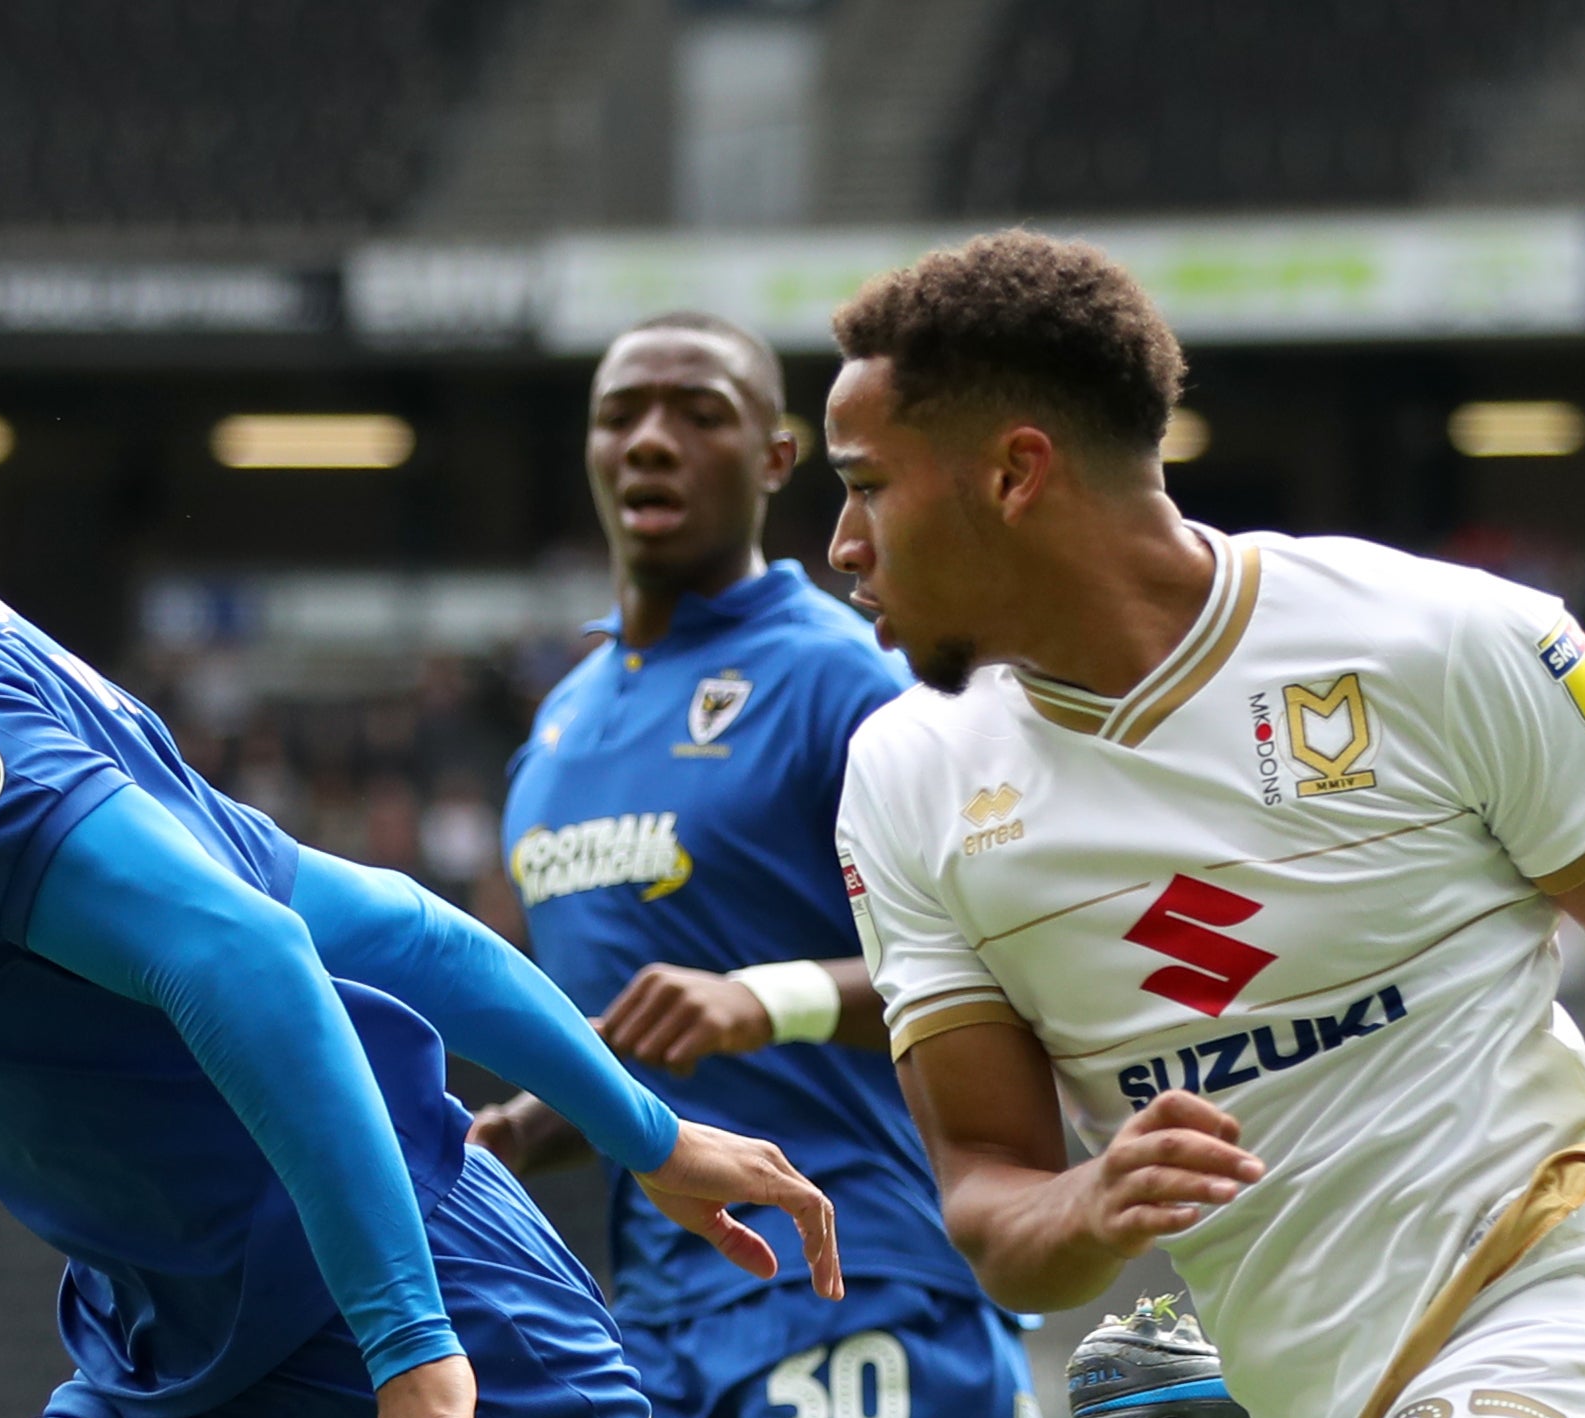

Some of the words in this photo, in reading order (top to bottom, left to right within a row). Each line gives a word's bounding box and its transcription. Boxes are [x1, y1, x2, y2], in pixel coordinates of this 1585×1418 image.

[1256, 740, 1282, 806] DONS
[1315, 778, 1356, 791] MMIV
[1118, 985, 1407, 1113] SUZUKI
